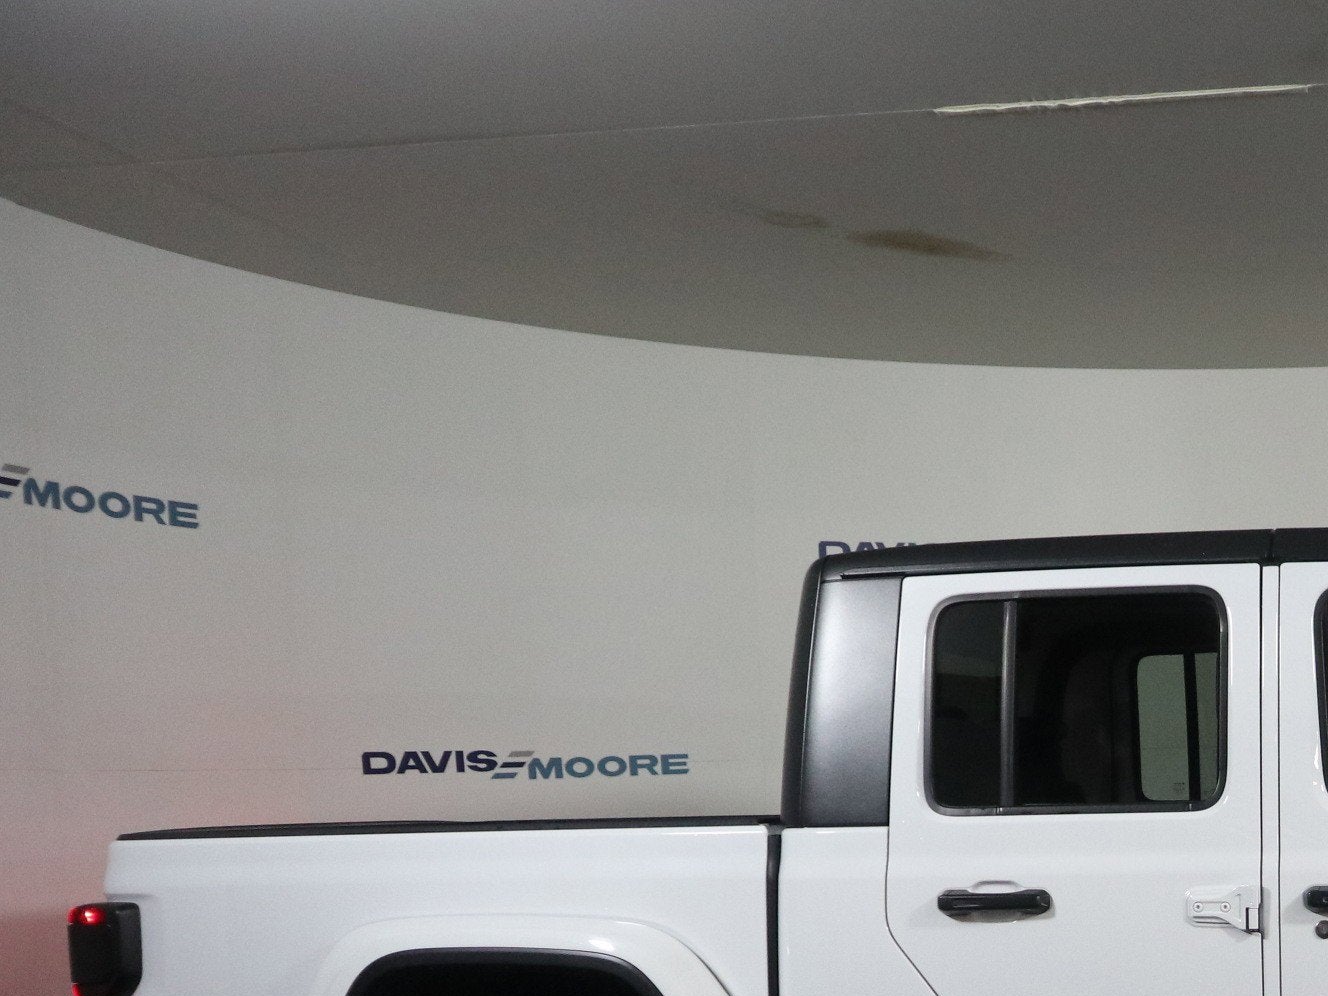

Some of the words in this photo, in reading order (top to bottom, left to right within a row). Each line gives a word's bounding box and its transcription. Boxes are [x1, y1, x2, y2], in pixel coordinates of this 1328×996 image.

[23, 478, 199, 529] MOORE
[362, 750, 498, 775] DAVIS
[528, 753, 690, 780] MOORE
